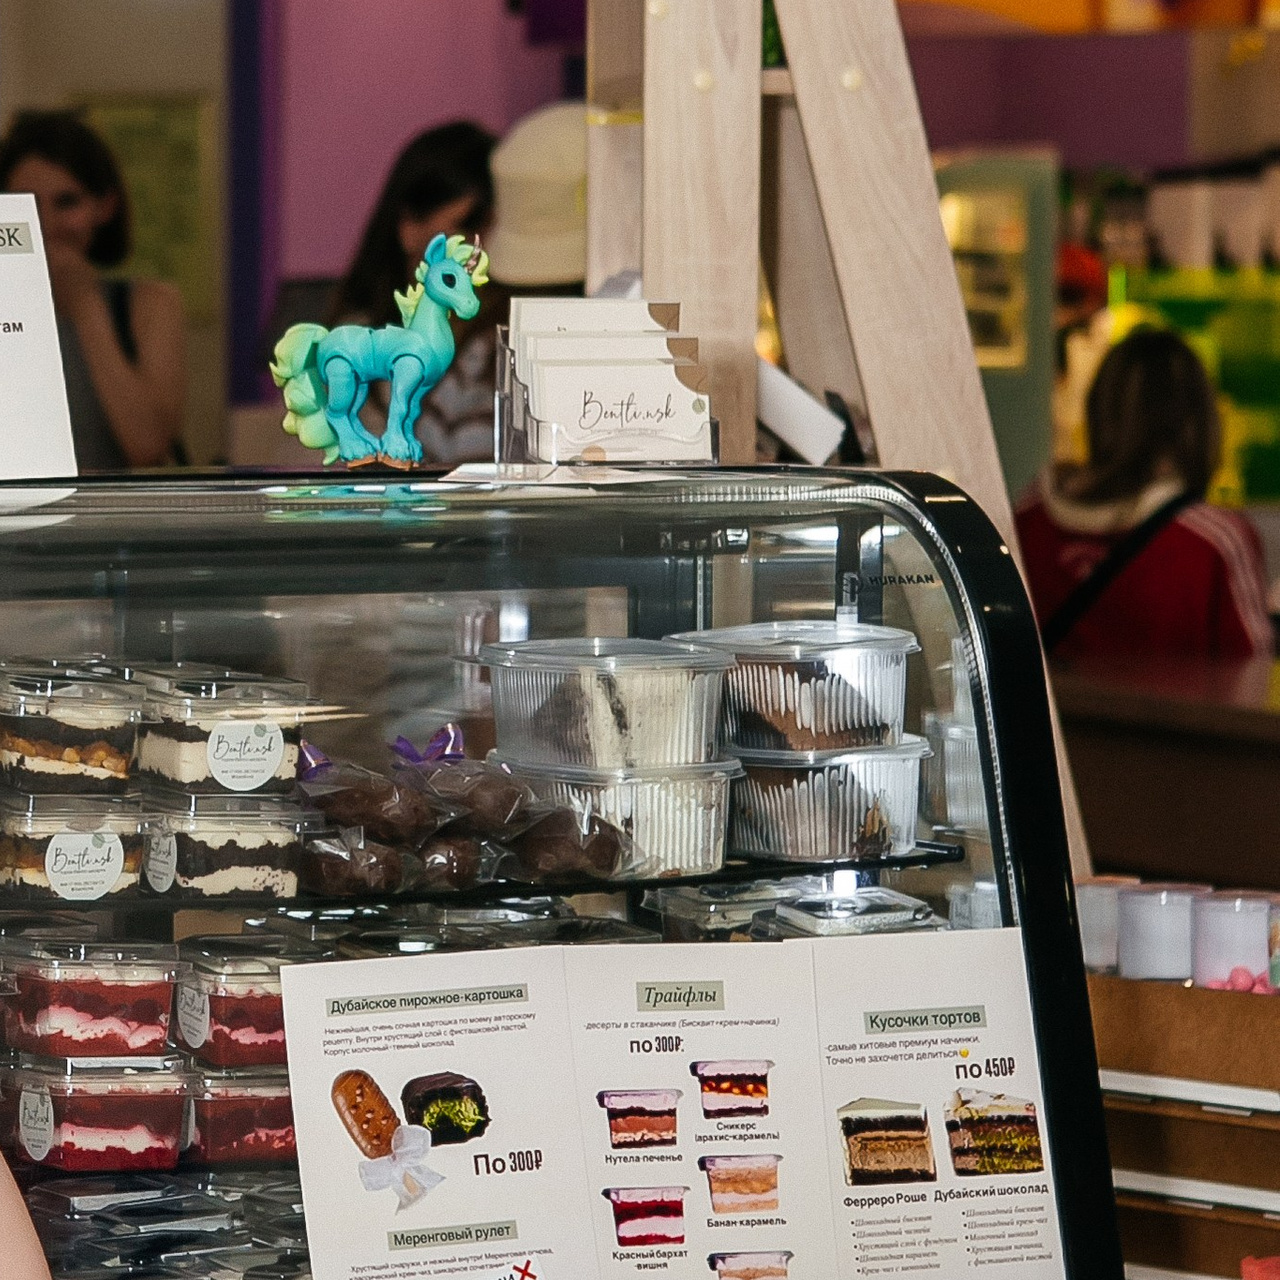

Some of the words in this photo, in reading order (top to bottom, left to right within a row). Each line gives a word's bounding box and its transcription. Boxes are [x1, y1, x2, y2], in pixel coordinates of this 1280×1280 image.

[868, 574, 935, 585] HURAKAN
[331, 997, 397, 1014] Дубайское
[399, 988, 524, 1008] пирожное-картошка
[644, 986, 716, 1007] Трайфлы
[870, 1014, 928, 1032] Кусочки
[931, 1011, 981, 1027] тортов
[630, 1040, 652, 1053] по
[955, 1063, 982, 1079] по
[716, 1121, 756, 1131] Сникерс
[473, 1154, 506, 1175] По
[509, 1149, 542, 1172] 300₽
[844, 1196, 895, 1209] Ферреро
[896, 1193, 927, 1203] Роше
[934, 1185, 995, 1202] Дубайский
[997, 1184, 1049, 1195] шоколад
[394, 1227, 472, 1247] Меренговый
[475, 1226, 510, 1241] рулет
[612, 1250, 654, 1260] Красный
[656, 1250, 688, 1259] бархат
